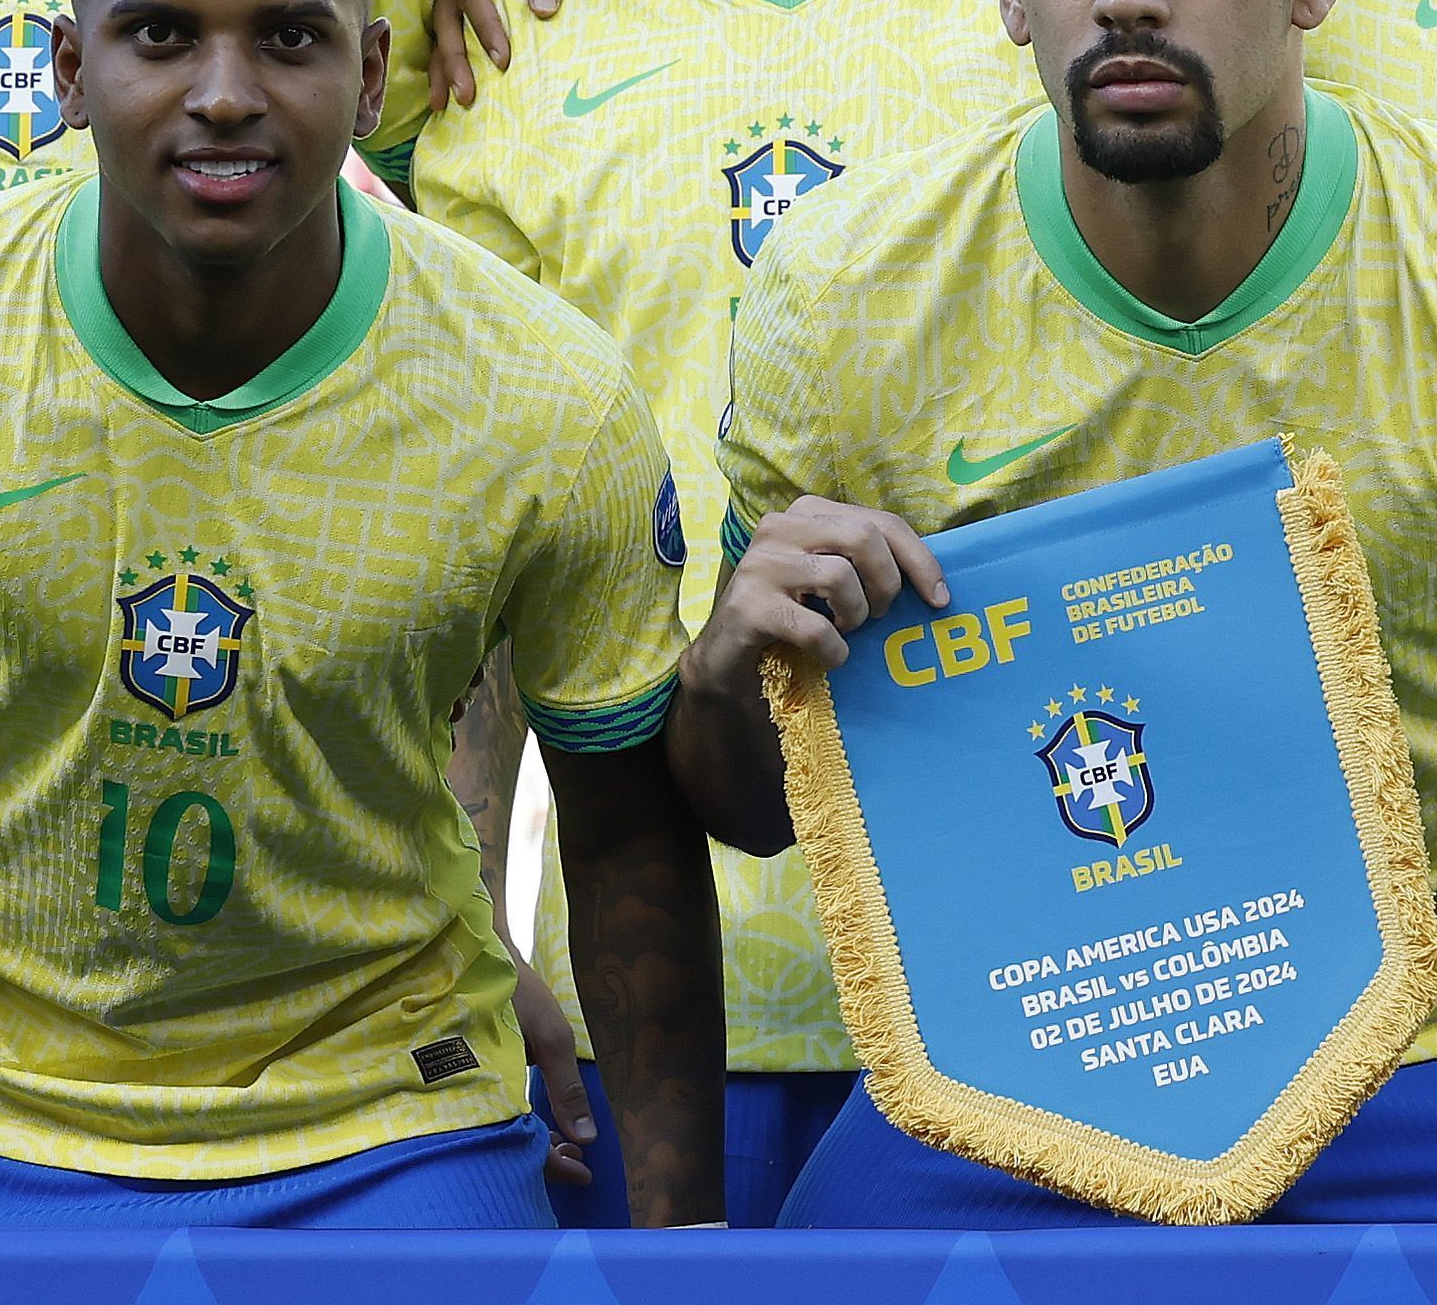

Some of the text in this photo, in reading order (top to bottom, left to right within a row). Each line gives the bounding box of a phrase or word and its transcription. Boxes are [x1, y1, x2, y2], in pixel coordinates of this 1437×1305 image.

[0, 72, 43, 89] CBF
[763, 199, 797, 216] CB
[1061, 543, 1234, 602] CONFEDERAÇÃO
[1065, 576, 1195, 623] BRASILEIRA
[1071, 596, 1206, 645] DE FUTEBOL
[157, 633, 206, 656] CBF
[883, 596, 1033, 687] CBF
[109, 718, 240, 758] BRASIL
[1079, 763, 1119, 788] CBF
[95, 780, 237, 928] 10
[1070, 843, 1184, 893] BRASIL
[988, 889, 1306, 992] COPA AMERICA USA 2024
[1021, 927, 1290, 1019] BRASIL vs COLÔMBIA
[1029, 961, 1298, 1051] 02 DE JULHO DE 2024
[1080, 1005, 1264, 1073] SANTA CLARA
[1152, 1055, 1210, 1088] EUA
